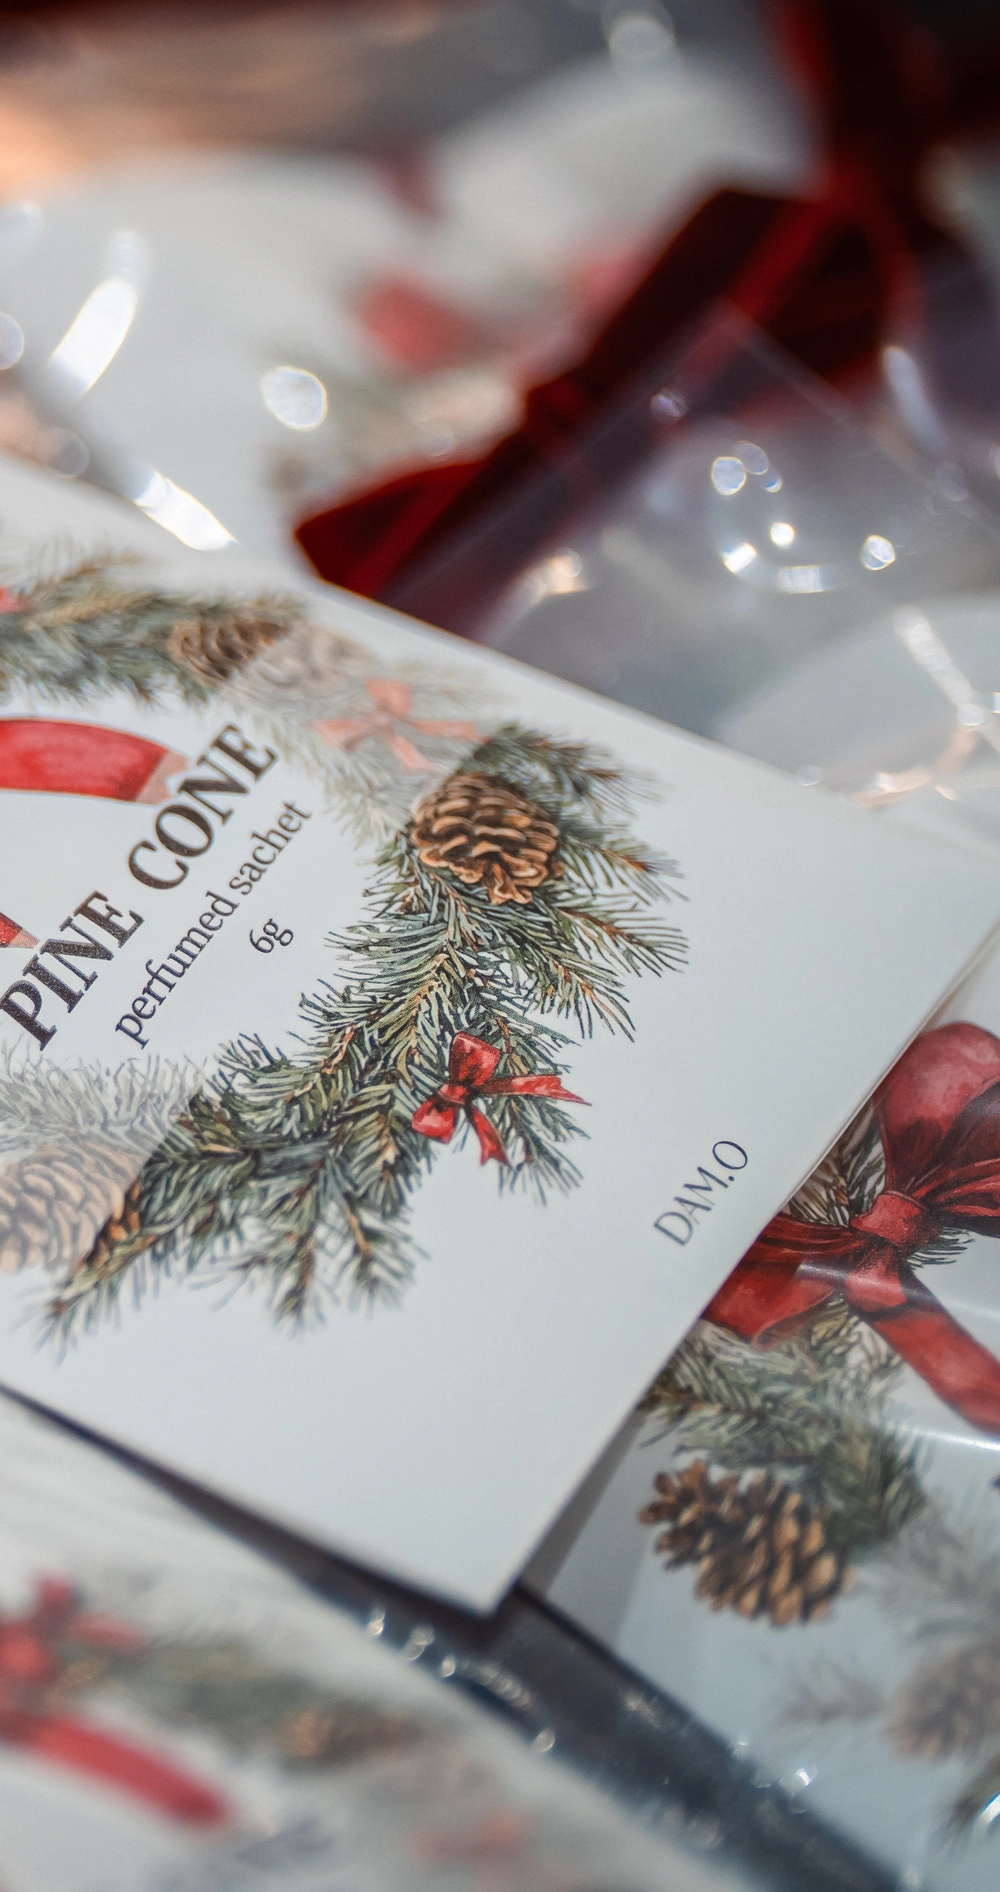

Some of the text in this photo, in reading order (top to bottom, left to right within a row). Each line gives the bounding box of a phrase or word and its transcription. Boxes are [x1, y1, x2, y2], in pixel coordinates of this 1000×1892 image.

[127, 723, 278, 890] CONE
[115, 801, 312, 1050] perfumed sachet
[249, 918, 294, 954] 6g
[653, 1140, 748, 1246] DAM.O
